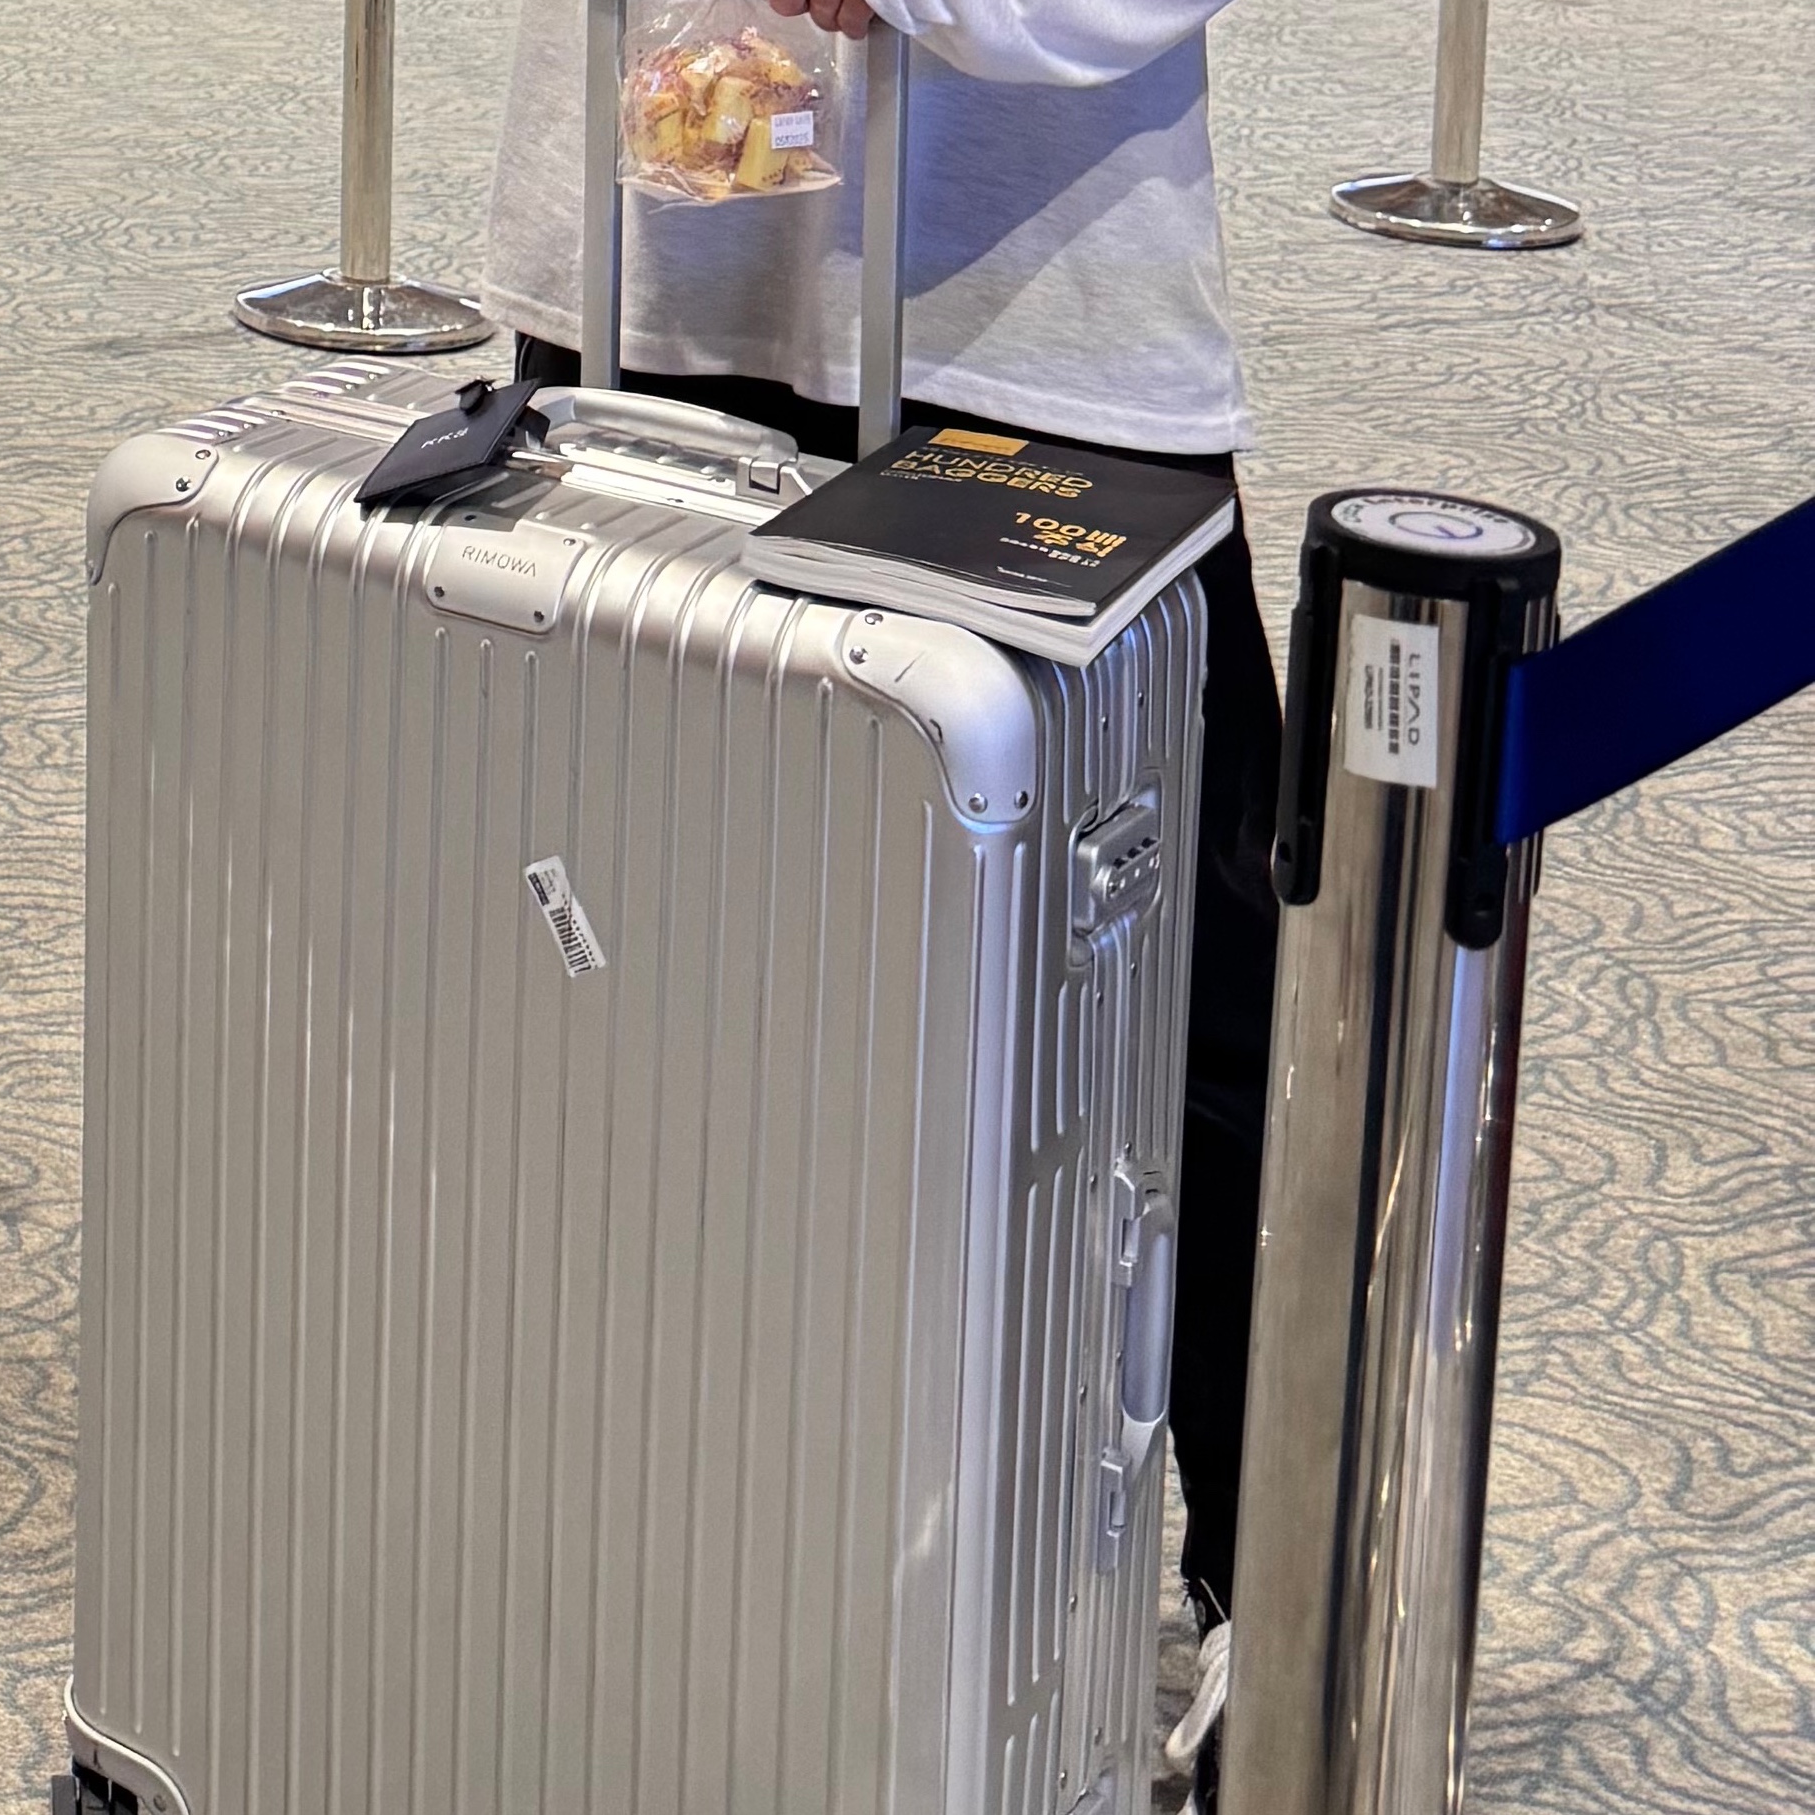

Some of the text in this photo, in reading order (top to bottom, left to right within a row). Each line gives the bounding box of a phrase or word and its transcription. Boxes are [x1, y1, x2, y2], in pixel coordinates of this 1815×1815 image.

[889, 460, 1082, 499] BAGGERS
[904, 449, 1094, 489] HUNDRED
[461, 544, 537, 578] RIMOWA
[1408, 653, 1422, 747] LIPAD
